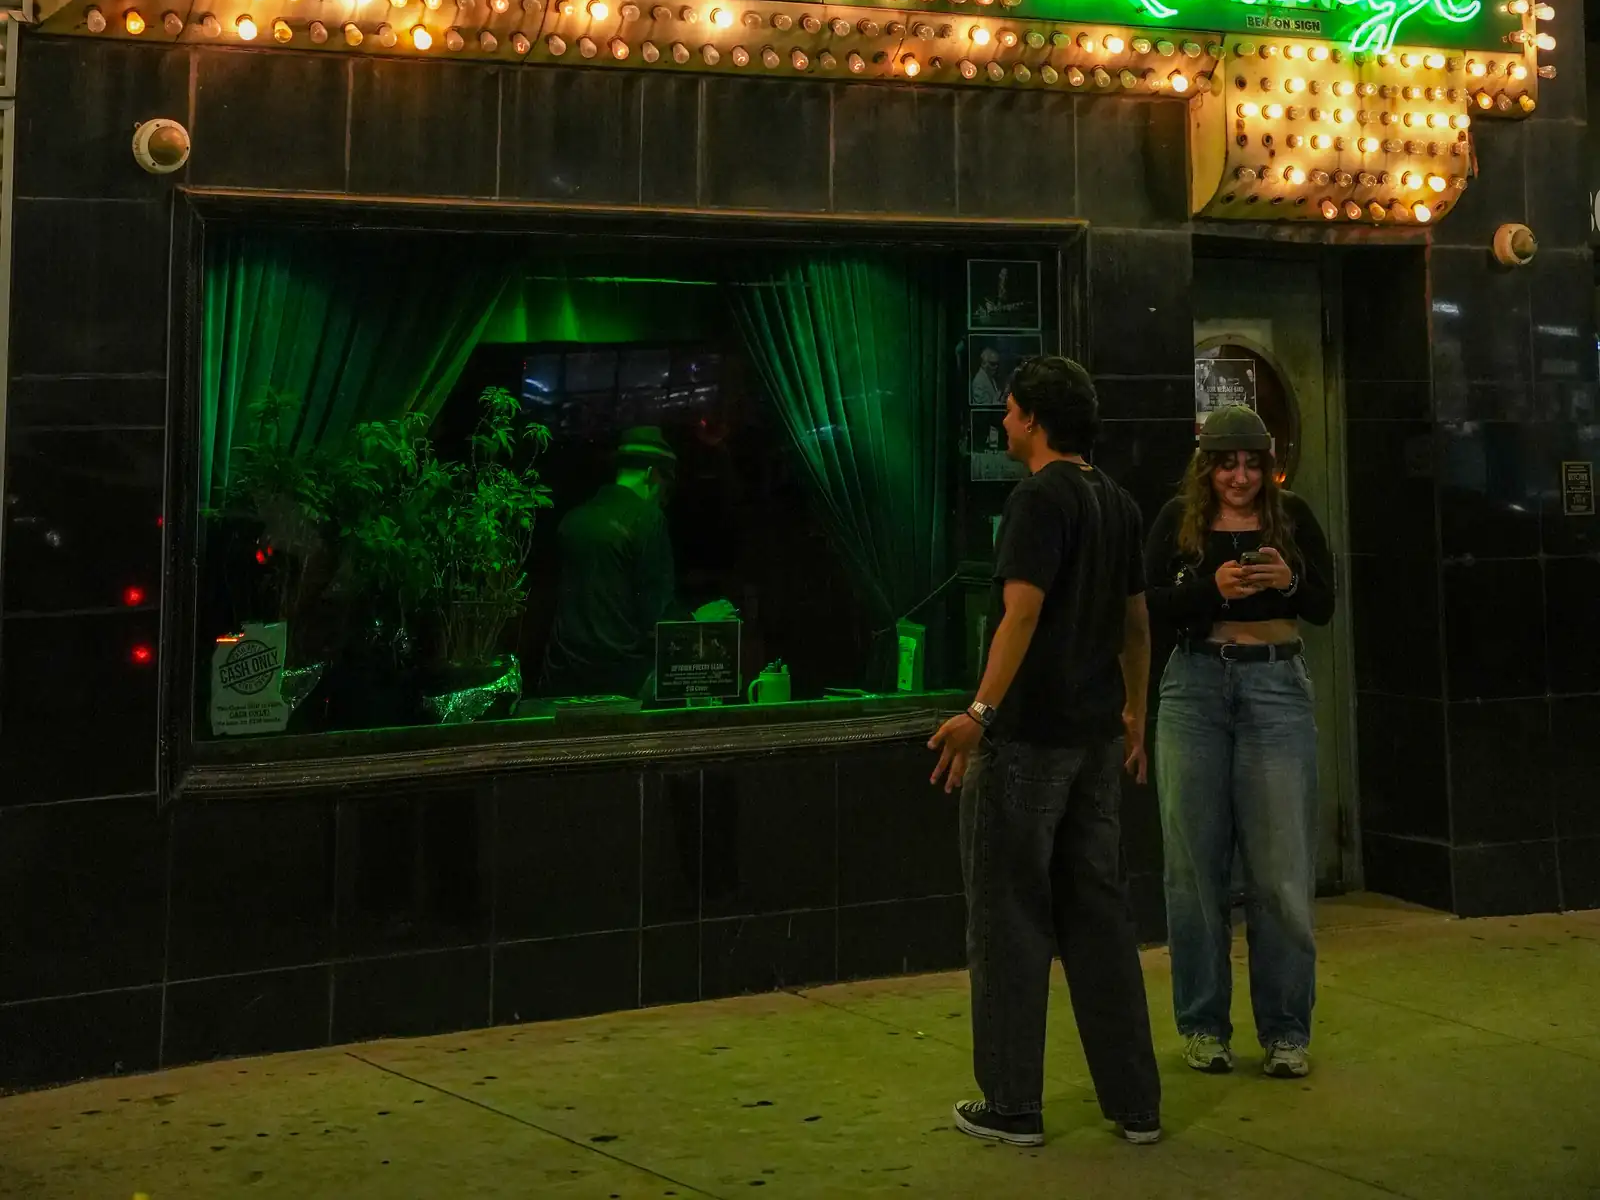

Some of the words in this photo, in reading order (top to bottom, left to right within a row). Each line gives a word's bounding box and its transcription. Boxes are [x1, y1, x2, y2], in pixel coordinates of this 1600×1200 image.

[1247, 16, 1290, 29] BEAON
[1294, 20, 1320, 31] SIGN
[220, 662, 251, 684] CASH
[252, 651, 278, 673] ONLY
